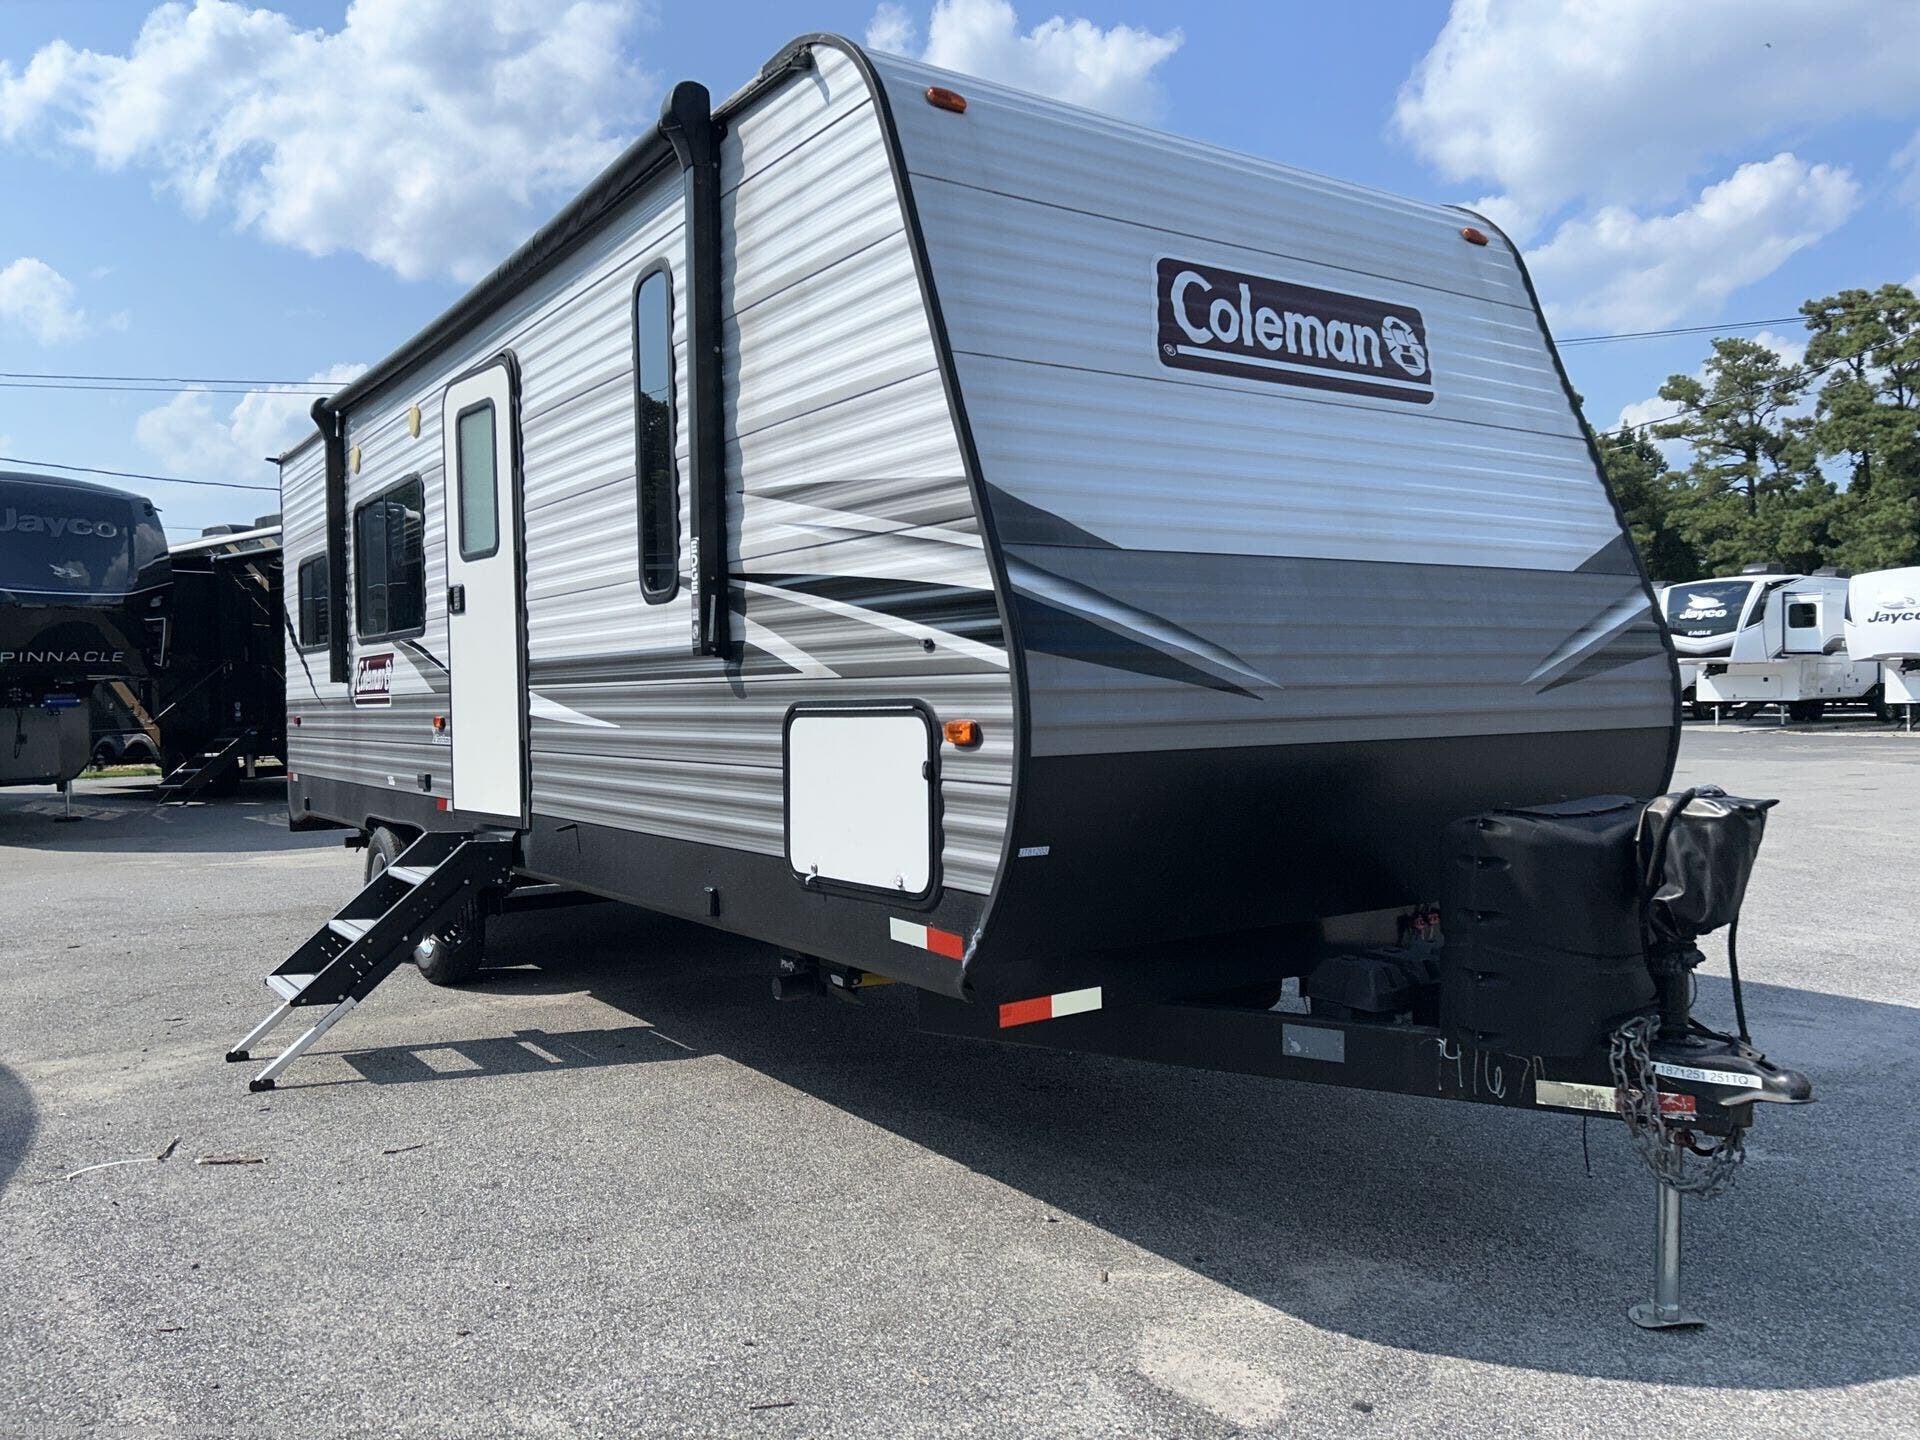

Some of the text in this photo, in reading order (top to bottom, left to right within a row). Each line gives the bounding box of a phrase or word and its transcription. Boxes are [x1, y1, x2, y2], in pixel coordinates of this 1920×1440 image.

[1170, 270, 1383, 368] Coleman
[0, 508, 118, 538] Jayco
[1679, 609, 1728, 620] Jayco
[0, 651, 125, 663] PINNACLE
[1660, 1065, 1749, 1085] 1871251 251TQ
